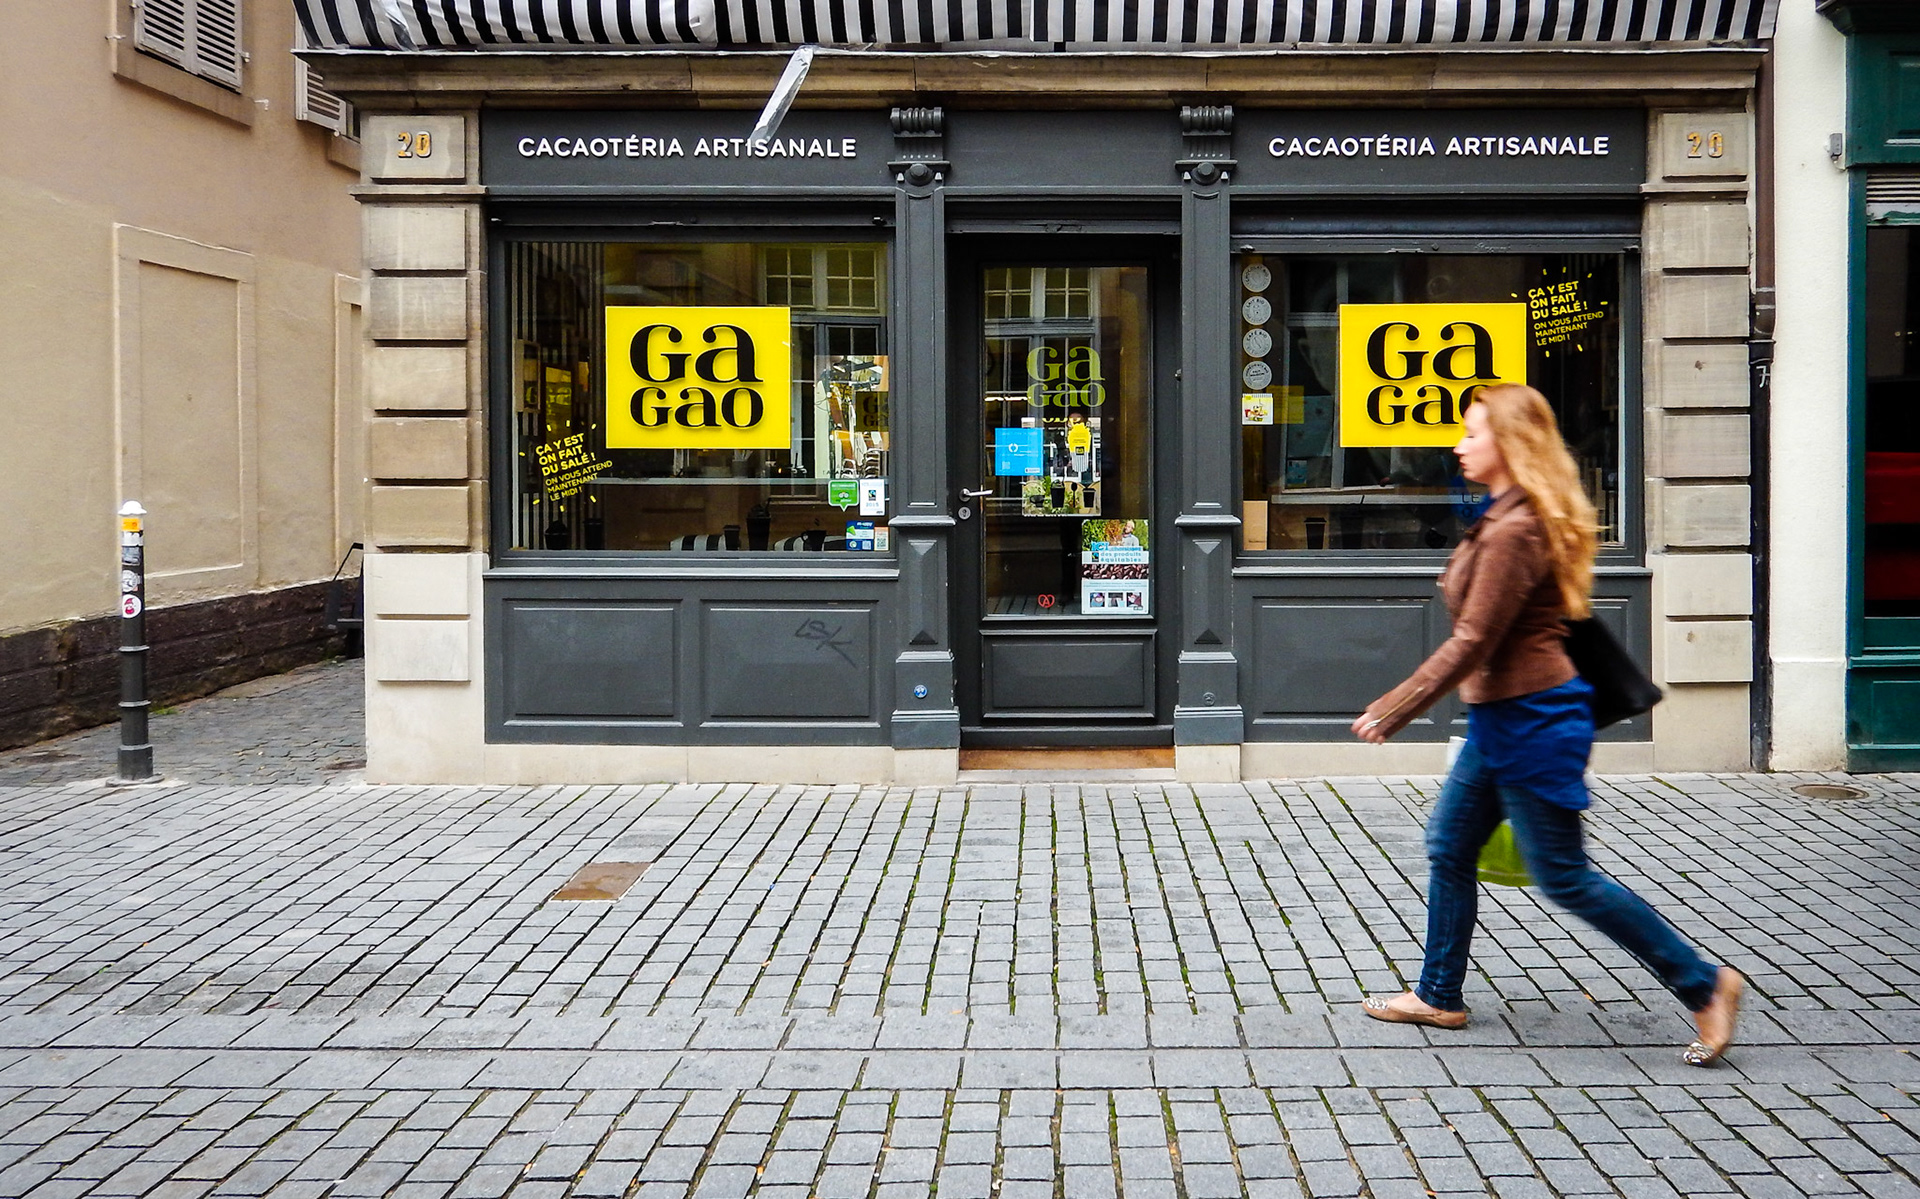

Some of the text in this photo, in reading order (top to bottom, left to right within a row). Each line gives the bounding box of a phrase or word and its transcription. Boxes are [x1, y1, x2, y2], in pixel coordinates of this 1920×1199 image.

[398, 131, 431, 158] 20
[518, 134, 857, 157] CACAOTÉRIA ARTISANALE
[1268, 133, 1610, 157] CACAOTÉRIA ARTISANALE
[1687, 131, 1723, 158] 20
[1528, 280, 1579, 300] ÇA Y EST
[1530, 292, 1577, 309] ON FAIT
[1532, 308, 1549, 320] DU
[1551, 300, 1582, 316] SALÉ
[1534, 311, 1604, 331] ON VOUS ATTEND
[1535, 322, 1588, 338] MAINTENANT
[1536, 338, 1547, 346] LE
[1548, 335, 1566, 344] MIDI
[535, 433, 584, 457] ÇA Y EST
[538, 445, 583, 466] ON FAIT
[541, 465, 559, 476] DU
[561, 453, 590, 471] SALÉ
[545, 460, 613, 487] ON VOUS ATTEND
[547, 473, 598, 494] MAINTENANT
[550, 493, 562, 502] LE
[562, 488, 578, 498] MIDI
